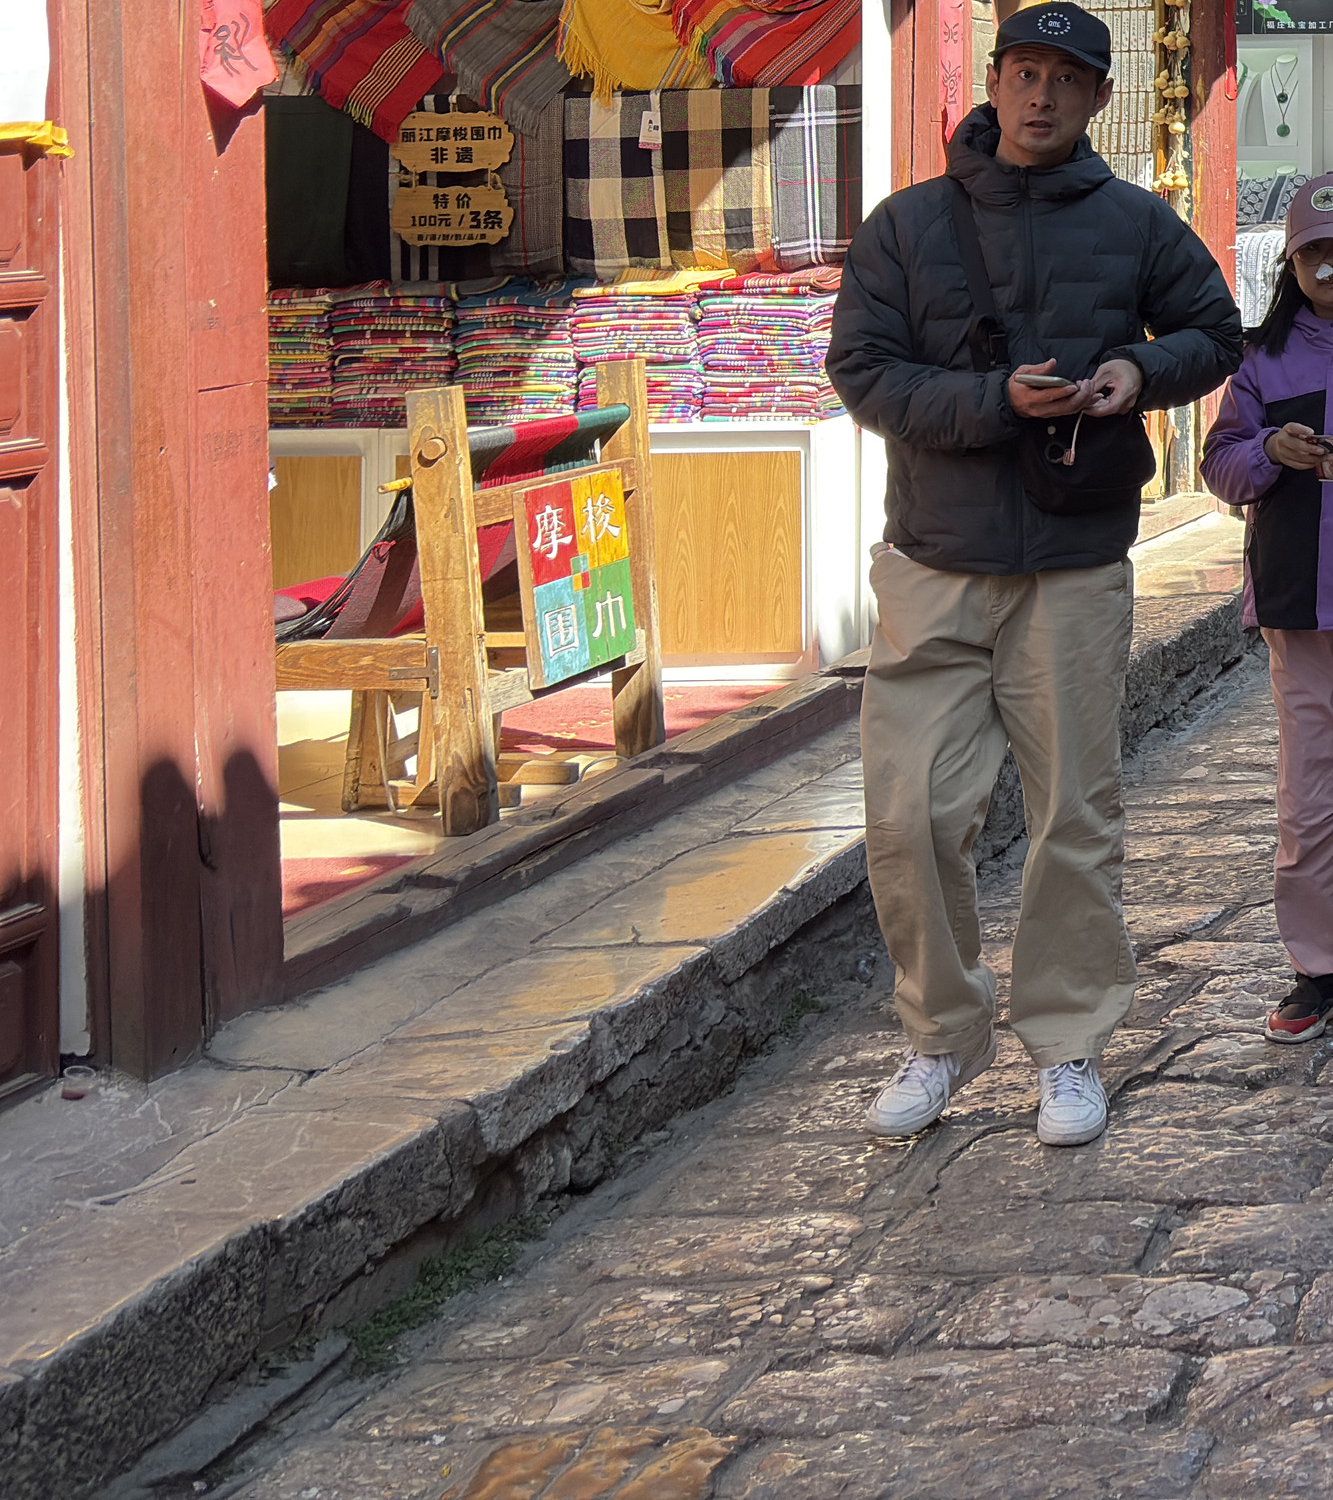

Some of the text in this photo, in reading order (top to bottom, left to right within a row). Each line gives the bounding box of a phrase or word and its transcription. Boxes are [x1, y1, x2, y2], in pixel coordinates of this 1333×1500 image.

[401, 126, 502, 142] 丽江摩梭围巾
[430, 147, 473, 164] 非遗
[433, 193, 472, 209] 特价
[532, 493, 621, 560] 摩梭
[544, 590, 627, 659] 围巾
